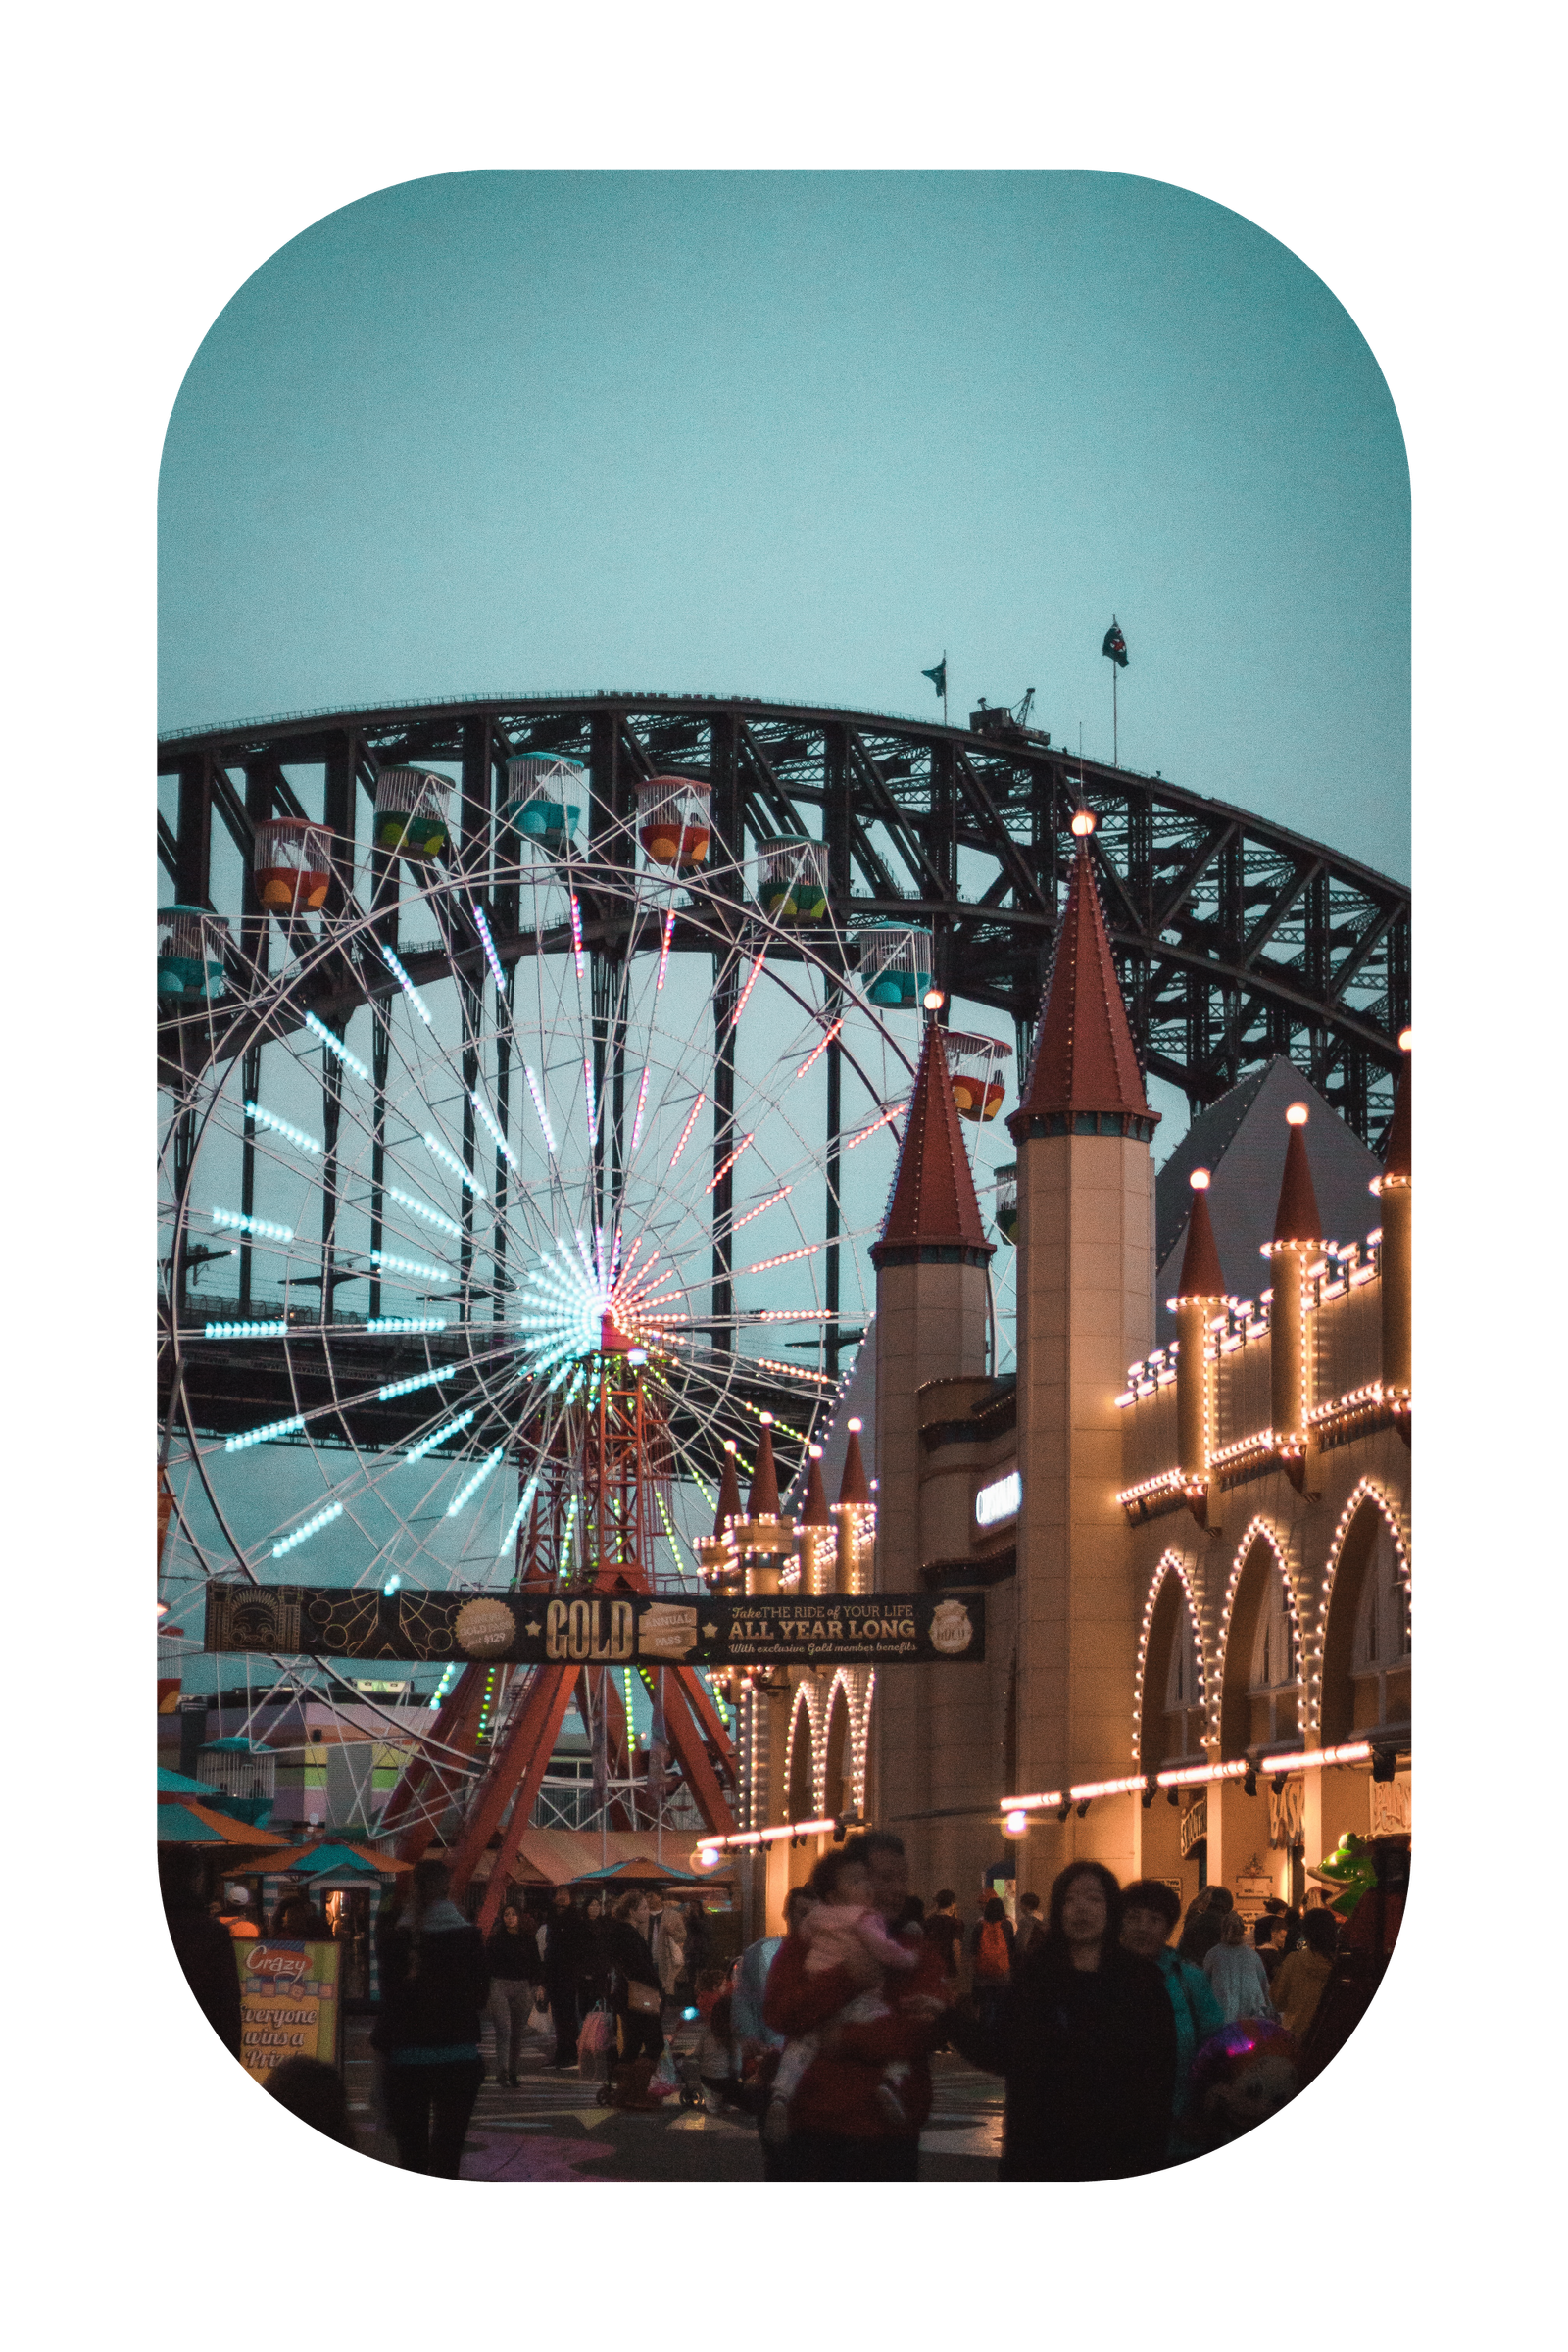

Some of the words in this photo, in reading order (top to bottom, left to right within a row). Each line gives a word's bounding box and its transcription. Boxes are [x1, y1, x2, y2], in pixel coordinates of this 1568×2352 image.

[731, 1606, 762, 1619] Take
[760, 1606, 791, 1618] THE
[794, 1606, 825, 1618] RIDE
[826, 1605, 841, 1620] of
[843, 1605, 880, 1618] YOUR
[884, 1604, 913, 1617] LIFE
[644, 1614, 692, 1628] ANNUAL
[459, 1625, 487, 1637] GOLD
[545, 1599, 634, 1660] GOLD
[728, 1621, 774, 1640] ALL
[778, 1620, 843, 1640] YEAR
[848, 1619, 916, 1640] LONG
[654, 1635, 682, 1647] PASS
[728, 1643, 755, 1653] With
[757, 1643, 805, 1653] exclusive
[808, 1642, 833, 1656] Gold
[834, 1642, 874, 1652] member
[876, 1642, 918, 1654] benefits
[245, 1944, 307, 1984] Crazy
[244, 2028, 289, 2046] wins
[290, 2032, 305, 2046] a
